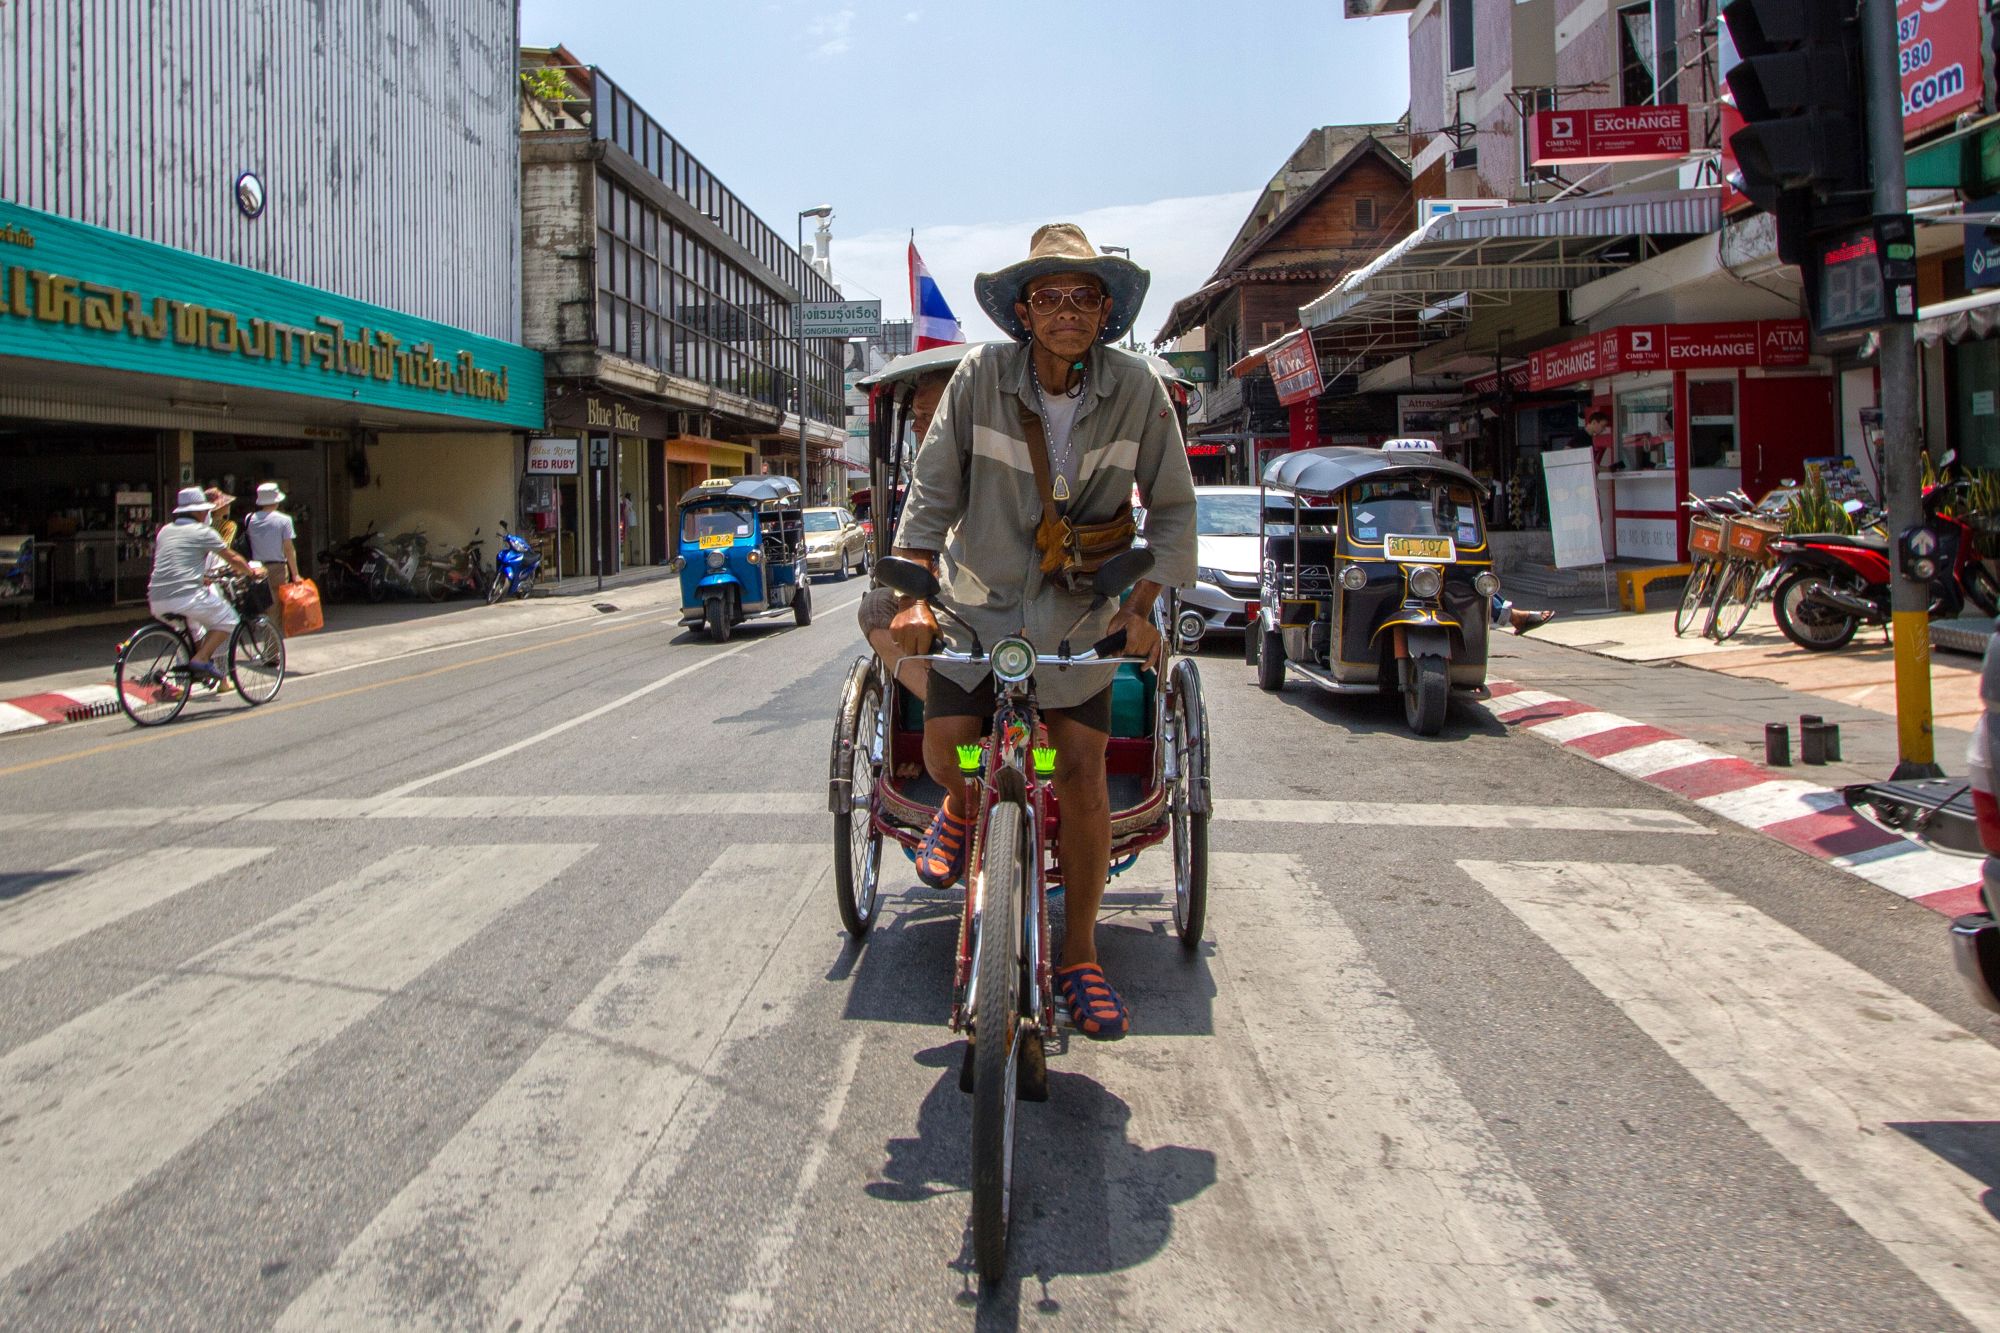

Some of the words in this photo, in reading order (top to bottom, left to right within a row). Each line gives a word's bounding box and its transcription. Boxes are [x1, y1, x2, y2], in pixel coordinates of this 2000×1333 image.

[1594, 115, 1681, 132] EXCHANGE
[1545, 140, 1564, 148] CIMB
[1657, 136, 1682, 146] ATM
[794, 327, 849, 335] RONGRUANG
[852, 326, 878, 334] HOTEL
[1765, 331, 1804, 346] ATM
[1602, 338, 1618, 356] ATM
[1670, 342, 1755, 358] EXCHANGE
[1625, 352, 1644, 360] CIMB
[1546, 350, 1596, 381] EXCHANGE
[587, 398, 612, 427] Blue
[614, 403, 640, 432] River
[1396, 440, 1429, 449] TAXI
[531, 459, 549, 469] RED
[550, 459, 575, 469] RUBY
[1420, 539, 1444, 551] 107
